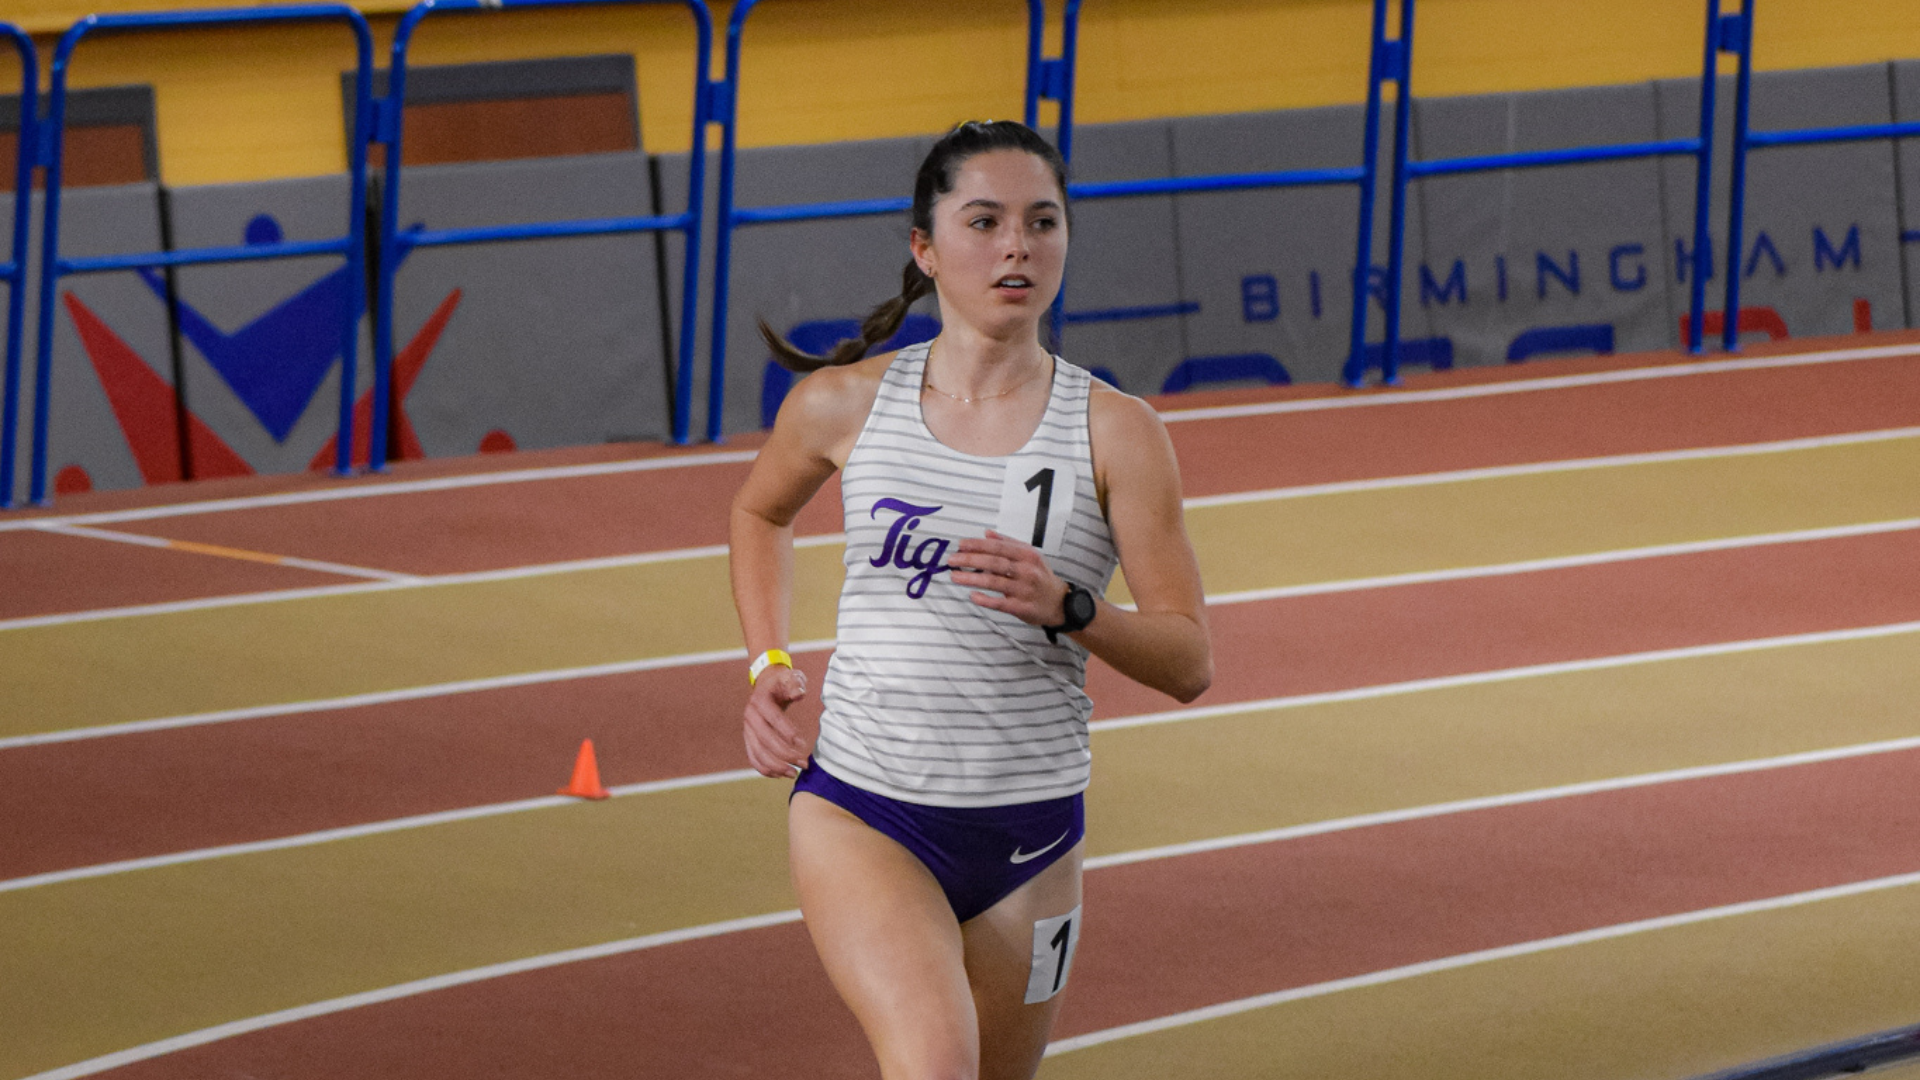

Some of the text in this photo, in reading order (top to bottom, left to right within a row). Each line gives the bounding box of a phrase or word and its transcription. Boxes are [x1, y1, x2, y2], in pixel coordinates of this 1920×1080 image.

[1242, 222, 1861, 323] BIRMINGHAM
[869, 497, 961, 599] Tig
[1024, 467, 1055, 549] 1
[1050, 918, 1071, 993] 1
